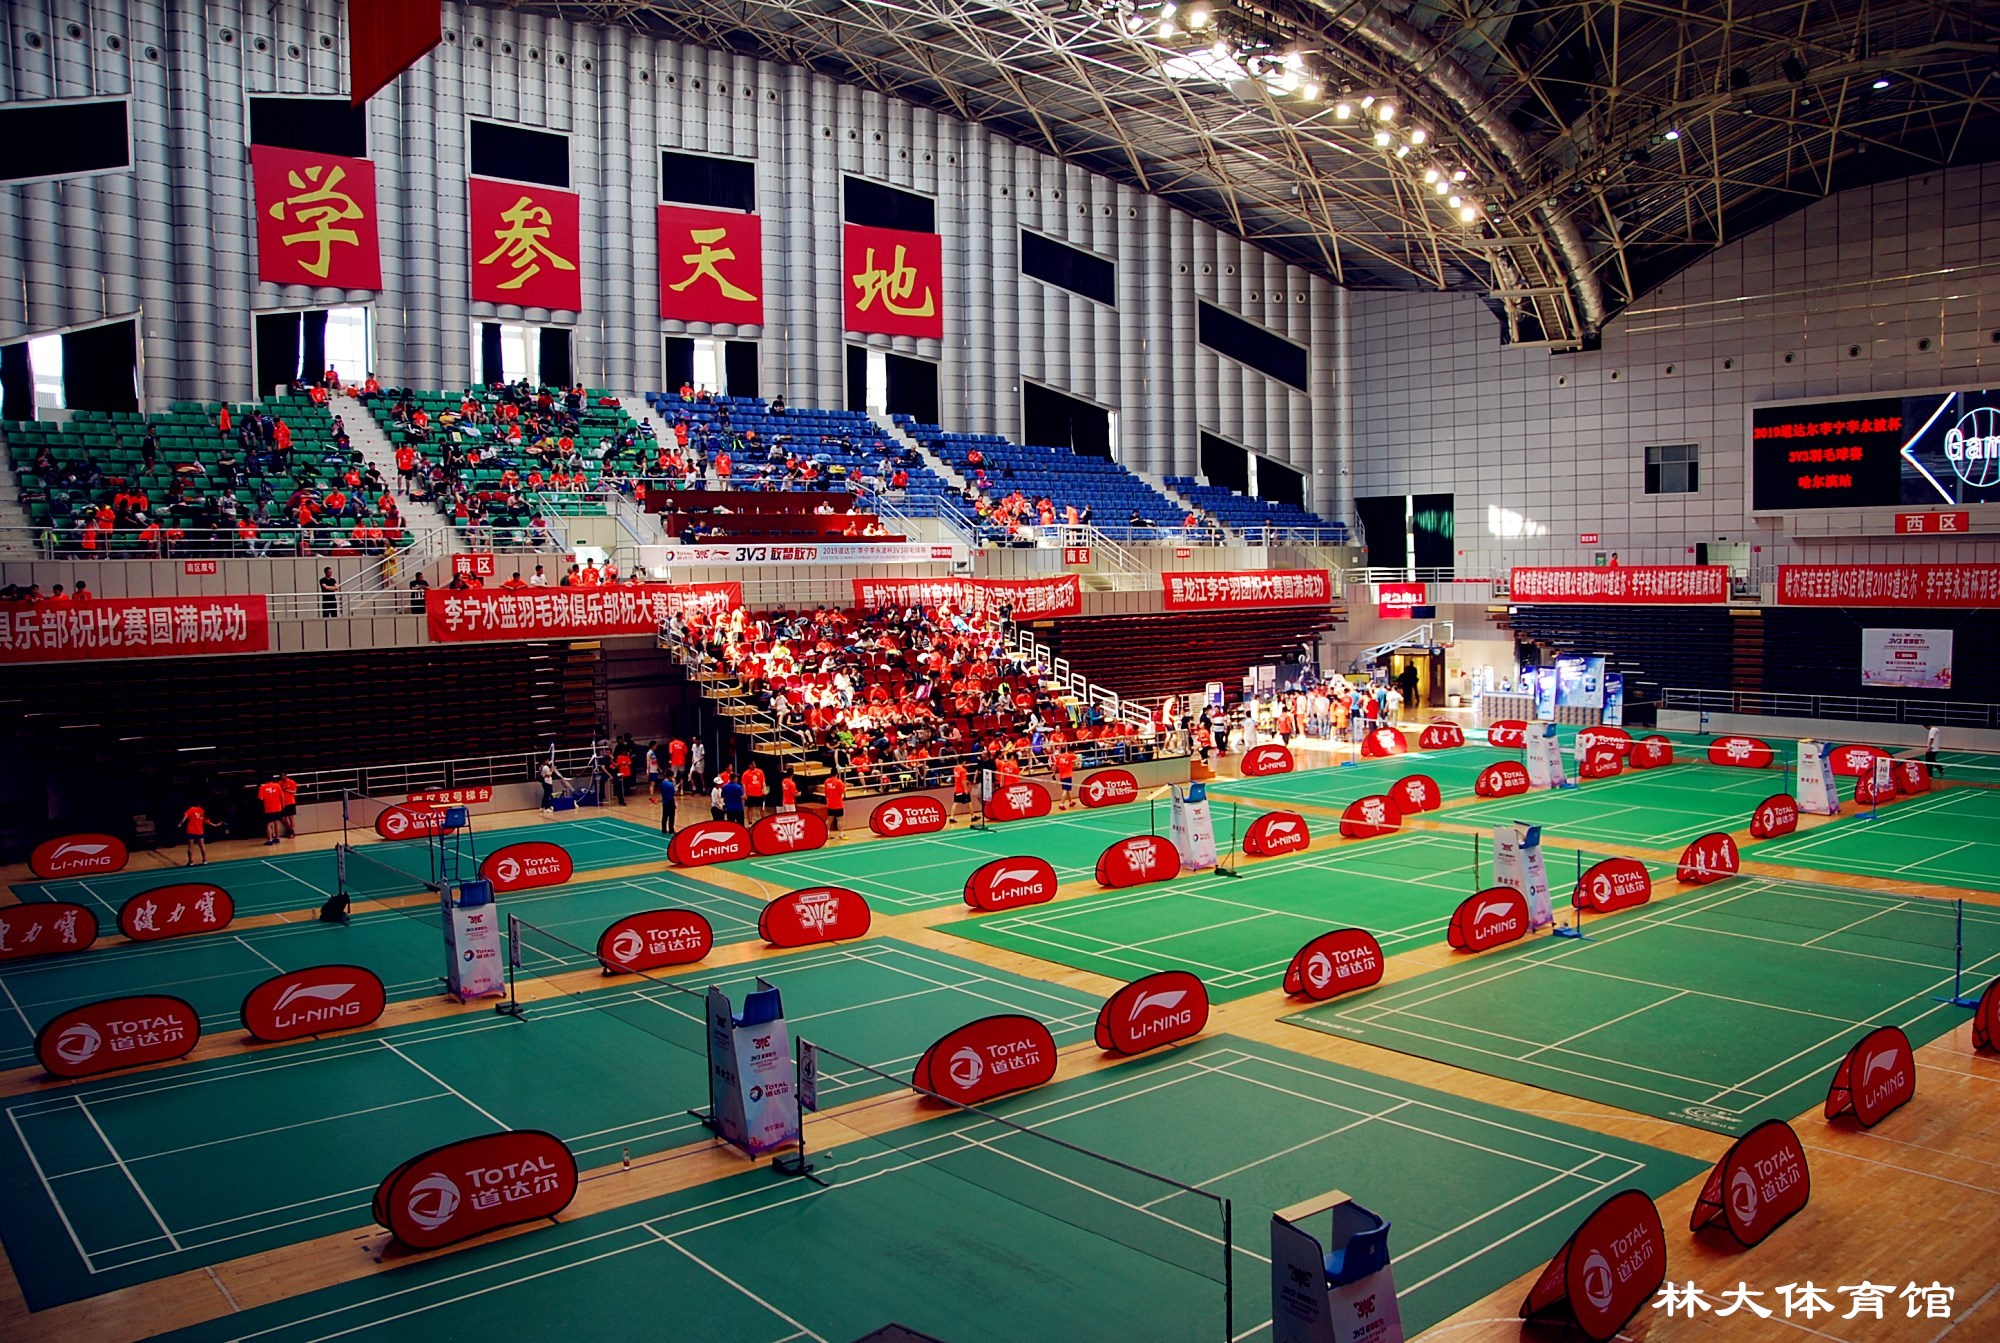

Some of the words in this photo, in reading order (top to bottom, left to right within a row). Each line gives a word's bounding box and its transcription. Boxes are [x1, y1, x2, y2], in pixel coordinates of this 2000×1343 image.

[269, 165, 364, 278] 学
[479, 196, 576, 289] 参
[669, 227, 758, 302] 天
[852, 244, 934, 317] 地
[736, 547, 767, 561] 3V3
[1105, 779, 1132, 788] TOTAL
[1502, 770, 1525, 779] TOTAL
[904, 806, 939, 817] TOTAL
[690, 843, 739, 859] LI-NING
[1267, 834, 1302, 849] LI-NING
[50, 856, 111, 871] LI-NING
[523, 857, 559, 867] TOTAL
[524, 864, 561, 877] 道达尔
[1611, 870, 1643, 884] TOTAL
[992, 882, 1043, 902] LI-NING
[1614, 881, 1645, 897] 道达尔
[646, 925, 700, 941] TOTAL
[1475, 917, 1517, 940] LI-NING
[648, 937, 702, 955] 道达尔
[1331, 945, 1373, 964] TOTAL
[1335, 956, 1376, 979] 道达尔
[106, 1014, 183, 1035] TOTAL
[274, 1000, 361, 1029] LI-NING
[1130, 1009, 1192, 1041] LI-NING
[109, 1027, 185, 1053] 道达尔
[986, 1038, 1037, 1060] TOTAL
[990, 1050, 1041, 1076] 道达尔
[765, 1081, 788, 1091] TOTAL
[1865, 1071, 1905, 1109] LI-NING
[465, 1155, 556, 1188] TOTAL
[1753, 1146, 1795, 1181] TOTAL
[470, 1172, 559, 1211] 道达尔
[1760, 1162, 1801, 1203] 道达尔
[1609, 1222, 1648, 1259] TOTAL
[1616, 1239, 1654, 1283] 道达尔
